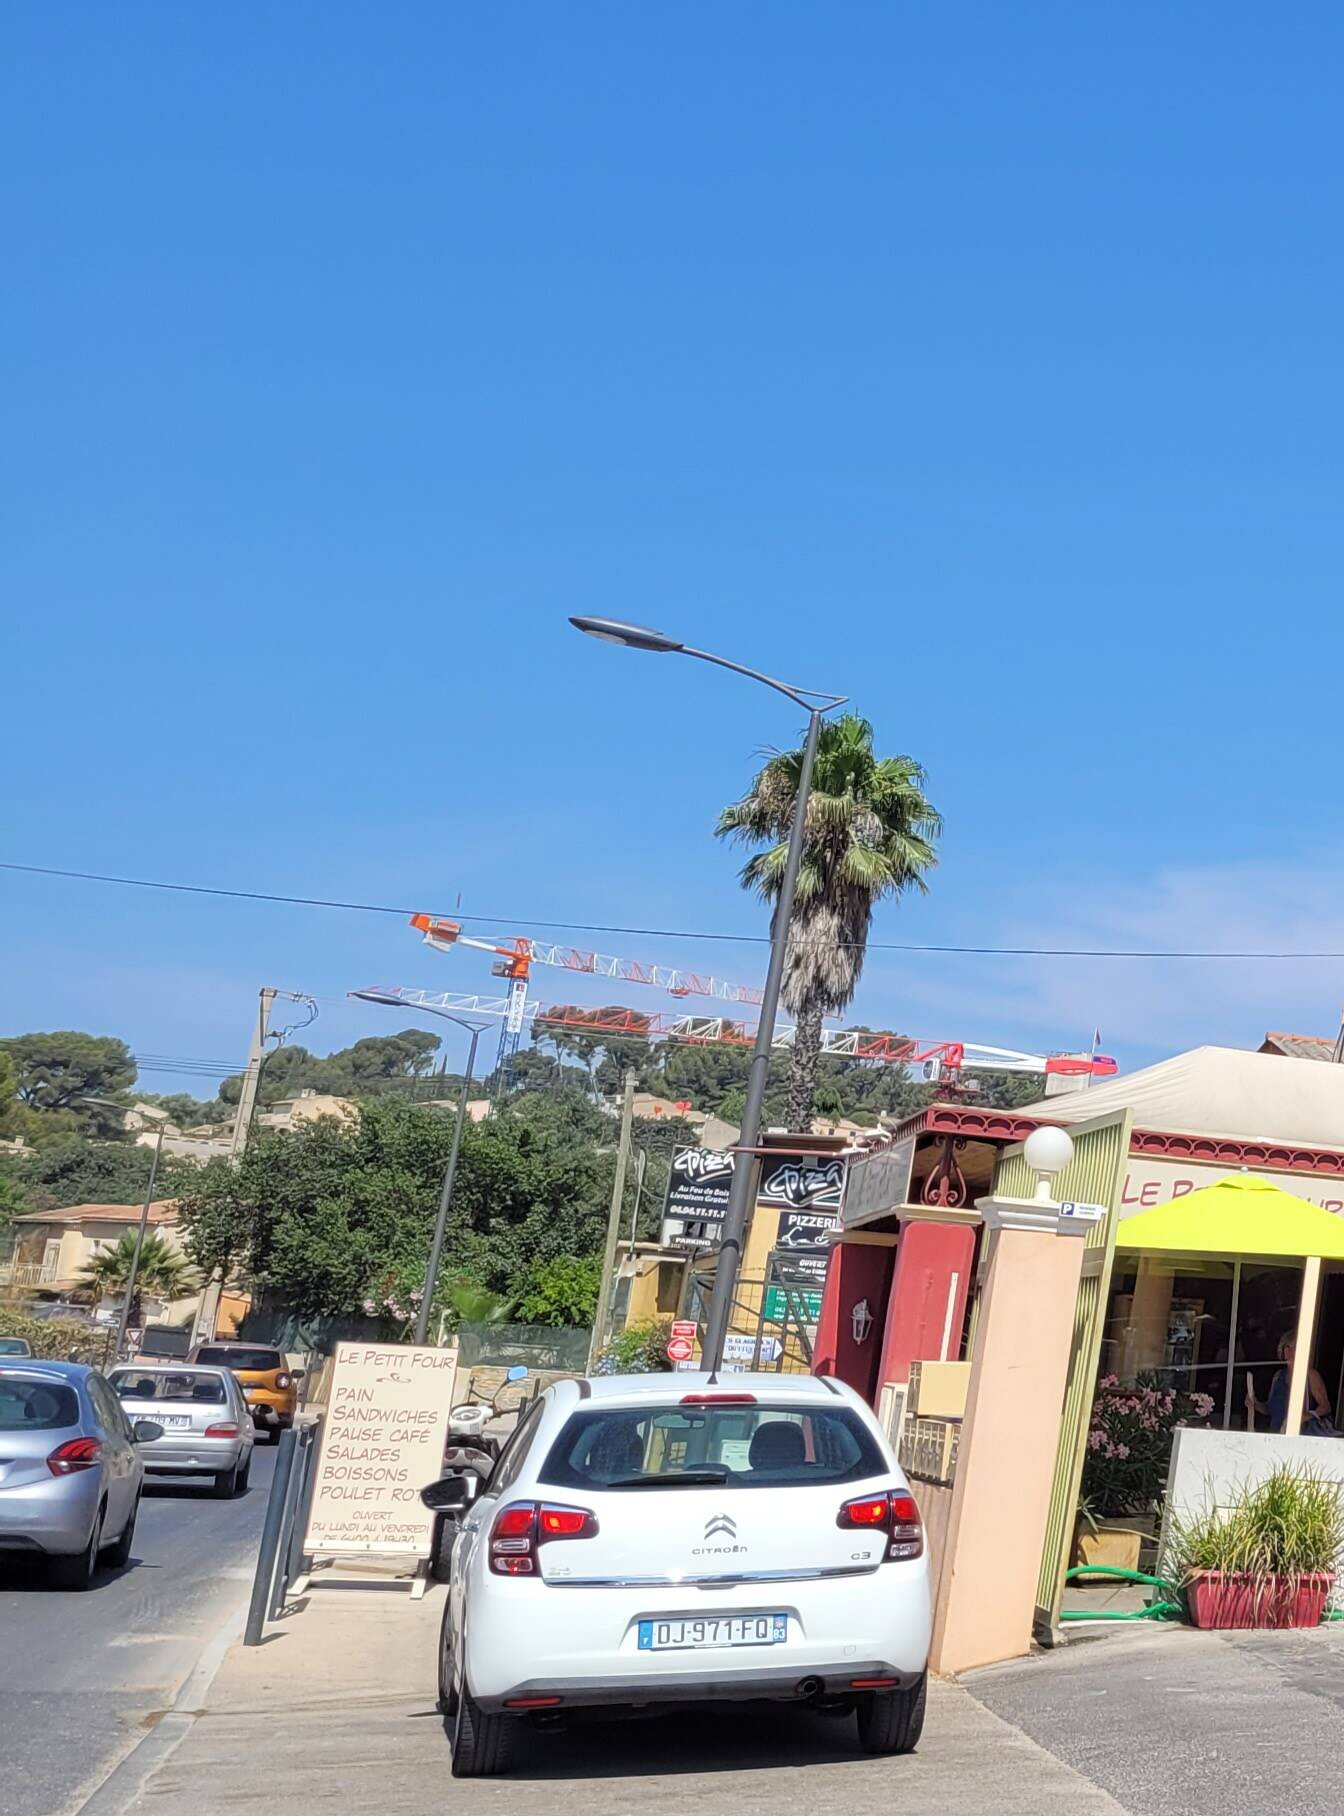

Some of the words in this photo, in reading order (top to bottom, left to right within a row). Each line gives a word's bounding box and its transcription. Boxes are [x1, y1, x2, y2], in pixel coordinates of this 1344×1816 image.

[1121, 1174, 1162, 1206] LE
[788, 1214, 837, 1228] PIZZERI
[675, 1237, 711, 1246] PARKING
[338, 1349, 358, 1364] LE
[363, 1351, 408, 1367] PETIT
[411, 1353, 454, 1369] FOUR
[336, 1388, 374, 1402] PAIN
[333, 1405, 438, 1424] SANDWICHES
[329, 1427, 384, 1441] PAUSE
[389, 1428, 431, 1443] CAFÉ
[326, 1445, 401, 1462] SALADES
[323, 1467, 408, 1482] BOISSONS
[320, 1486, 387, 1500] POULET
[352, 1510, 394, 1520] OUVERT
[311, 1522, 325, 1531] DU
[329, 1523, 359, 1532] LUNDI
[363, 1524, 378, 1532] AU
[850, 1551, 872, 1561] C3
[773, 1628, 785, 1640] 83
